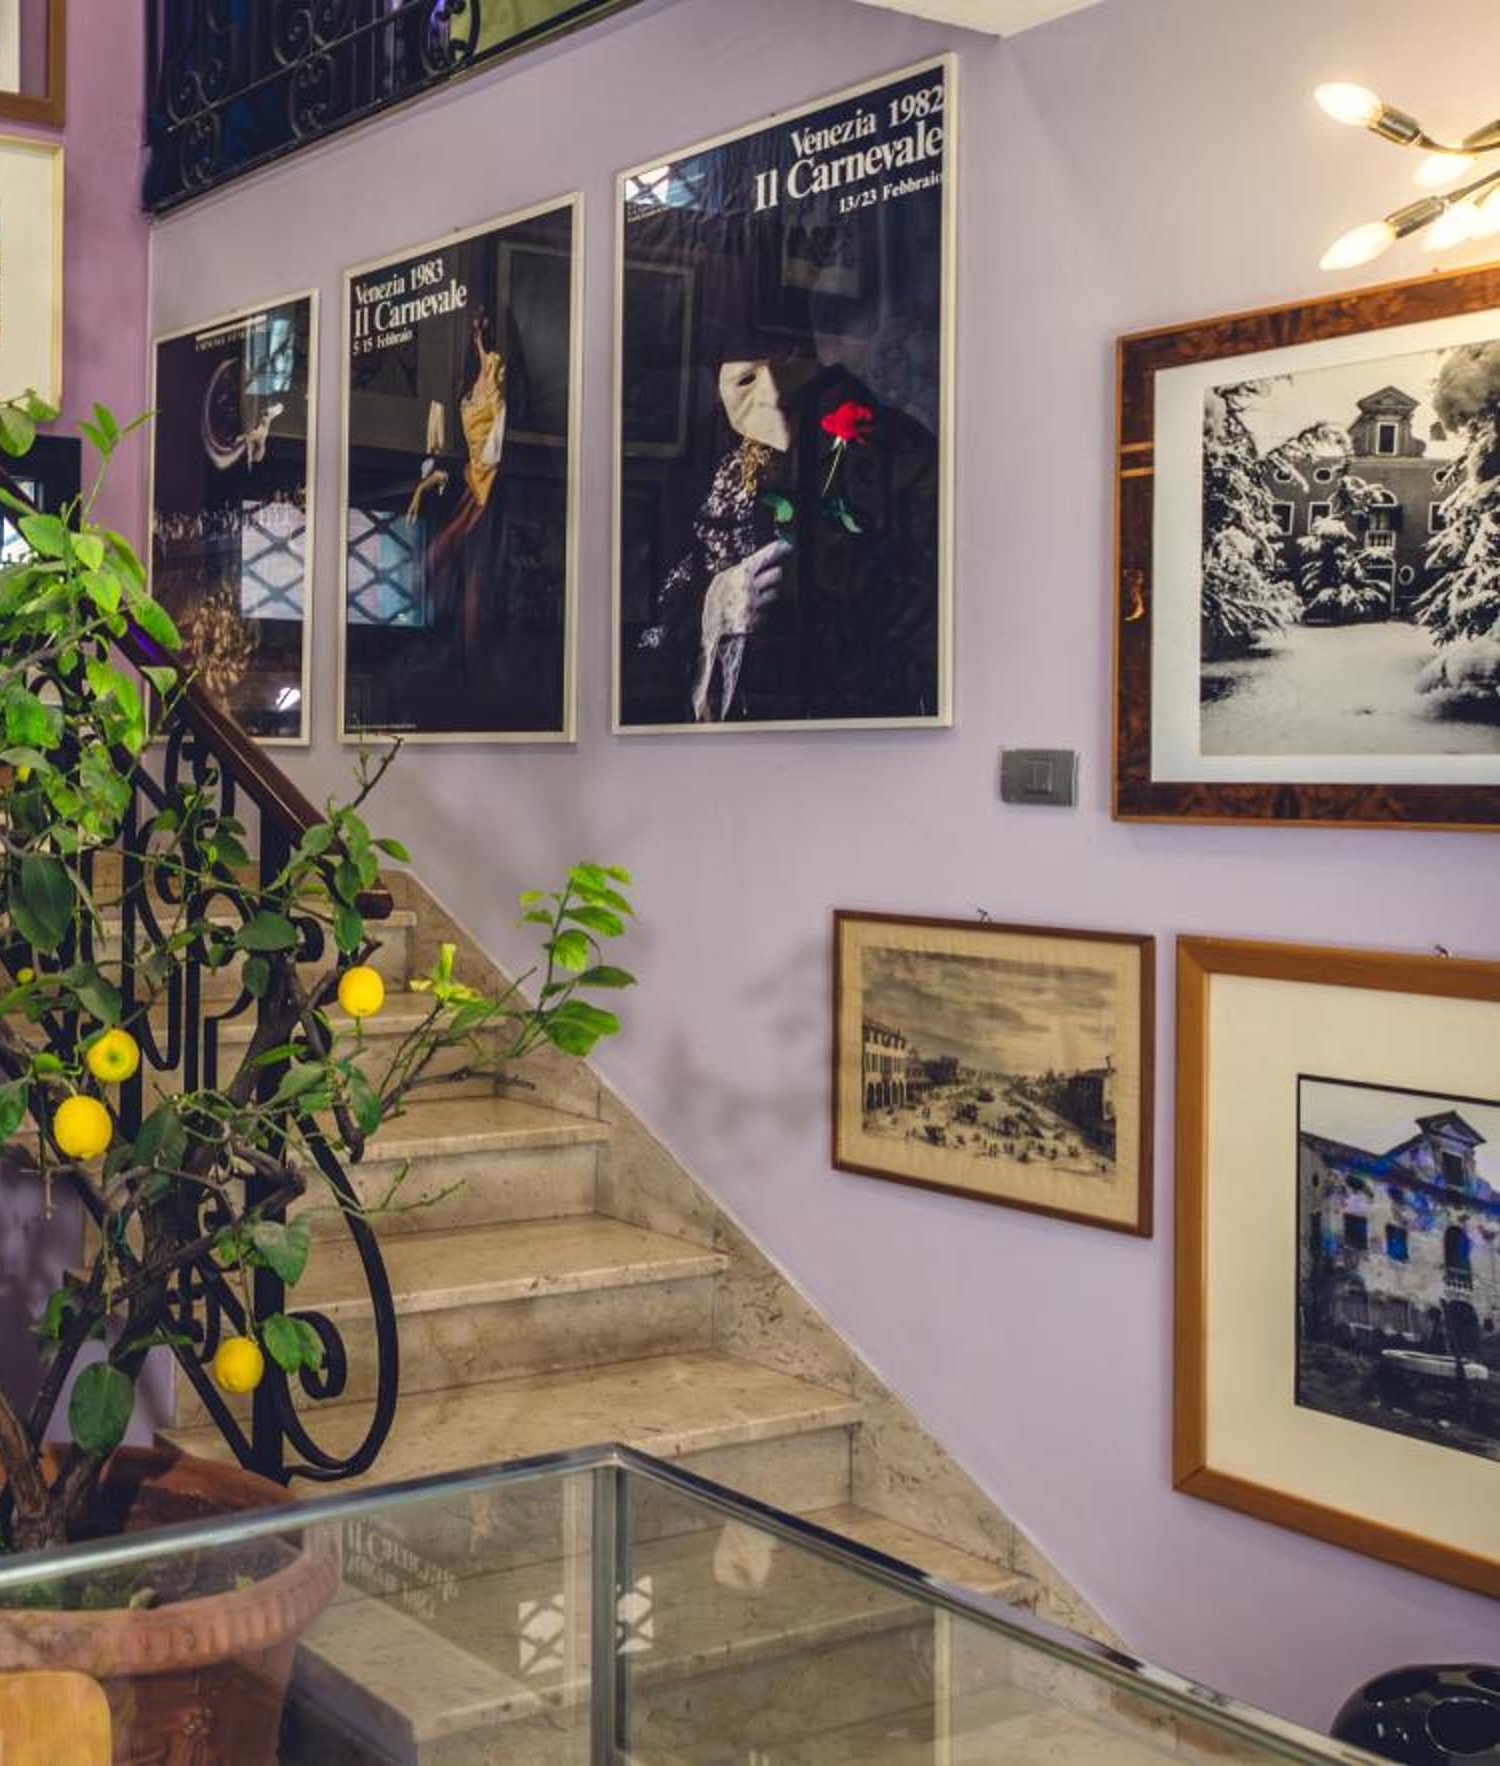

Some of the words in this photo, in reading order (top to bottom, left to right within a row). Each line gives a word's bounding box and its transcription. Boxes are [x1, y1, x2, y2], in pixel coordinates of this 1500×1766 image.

[790, 108, 877, 158] Venezia
[888, 84, 943, 127] 1982
[754, 169, 779, 212] Il
[787, 120, 943, 200] Carnevale
[839, 188, 877, 213] 13/23
[355, 273, 405, 305] Venezia
[410, 257, 444, 291] 1983
[355, 307, 369, 338] Il
[374, 278, 468, 332] Carnevale
[377, 327, 413, 349] Febbraio
